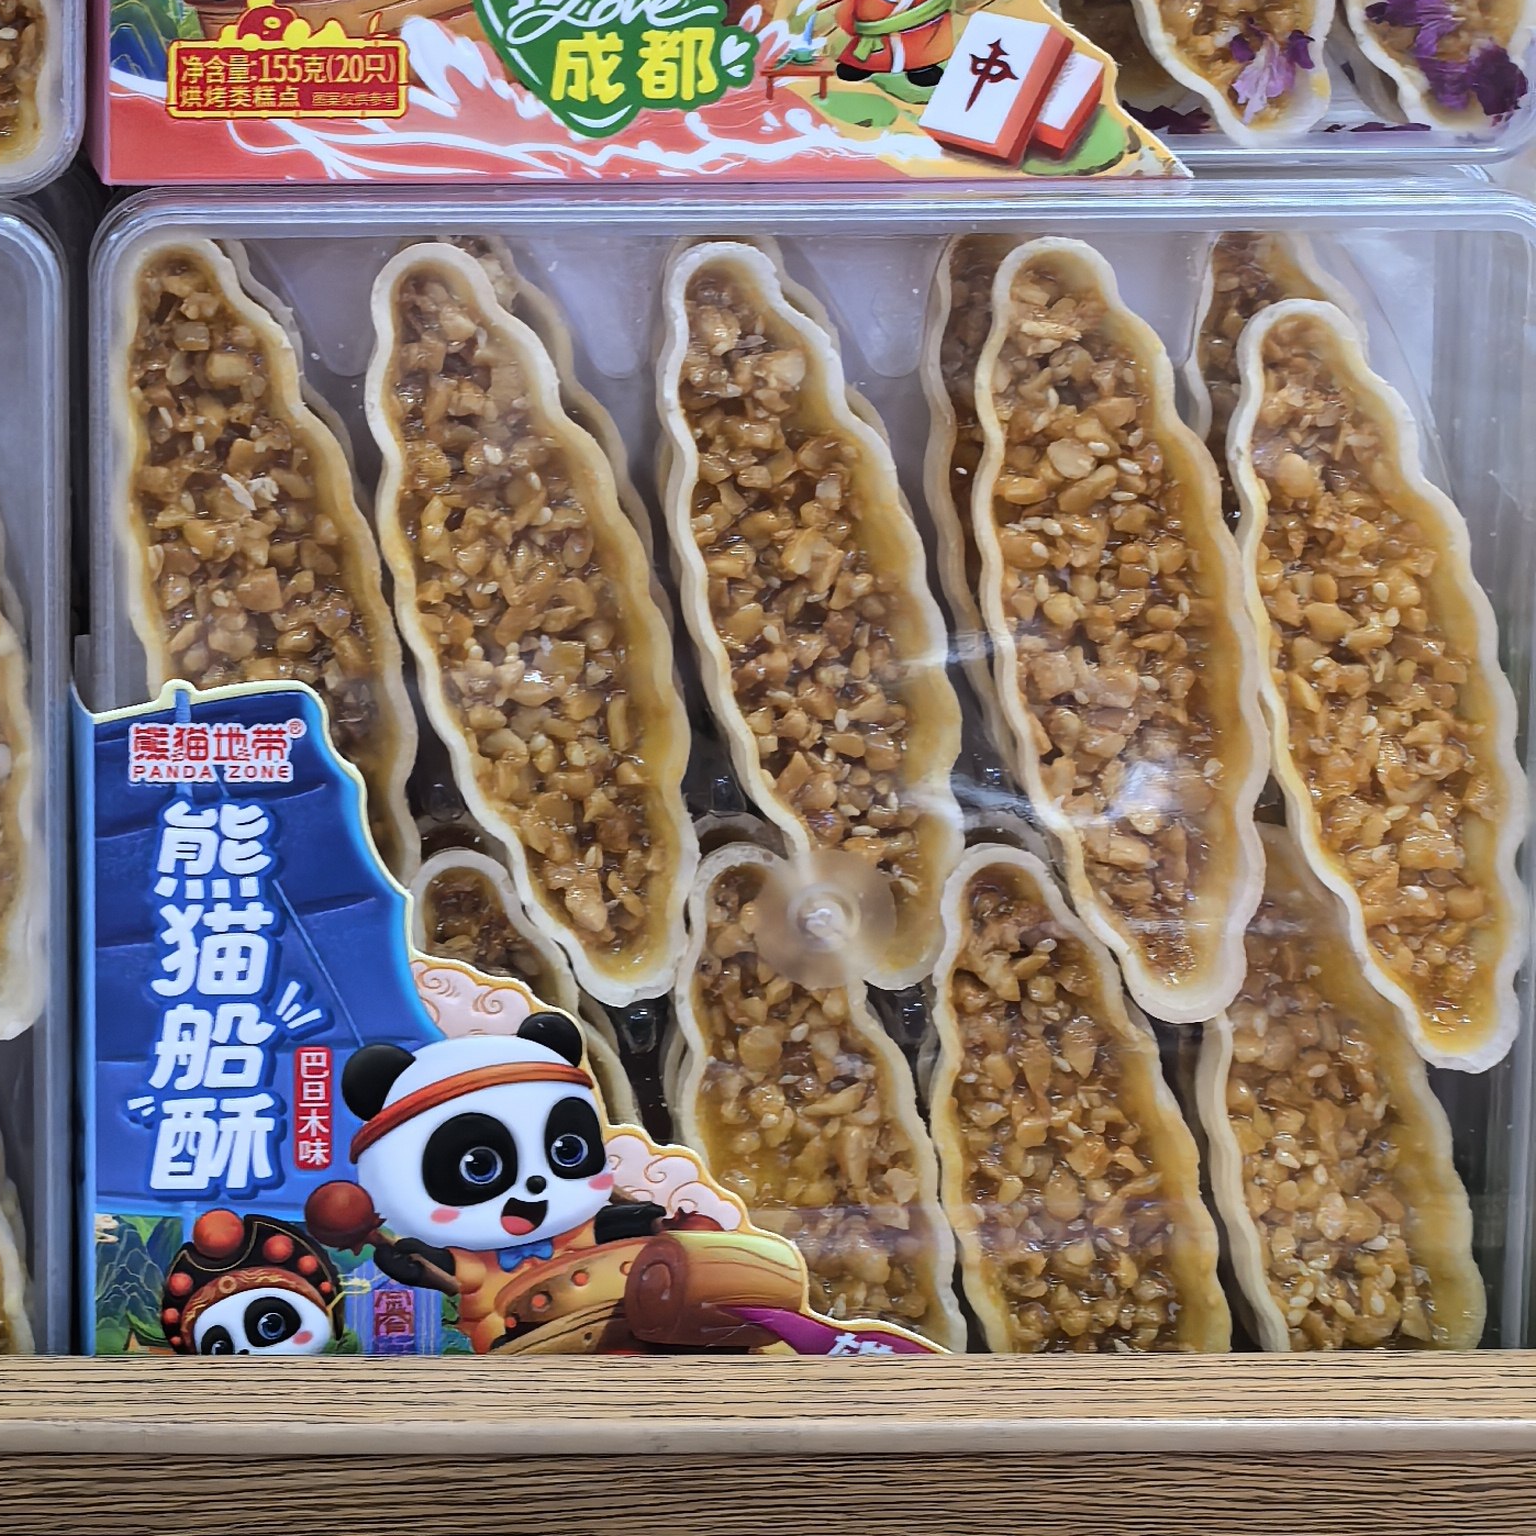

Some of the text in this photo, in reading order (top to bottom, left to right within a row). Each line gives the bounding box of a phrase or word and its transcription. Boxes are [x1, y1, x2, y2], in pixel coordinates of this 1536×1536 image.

[549, 26, 720, 105] 成都
[964, 37, 1020, 113] 中
[133, 765, 290, 780] PANDA ZONE
[148, 800, 275, 1191] 熊猫船酥
[298, 1050, 330, 1166] 巴旦木味
